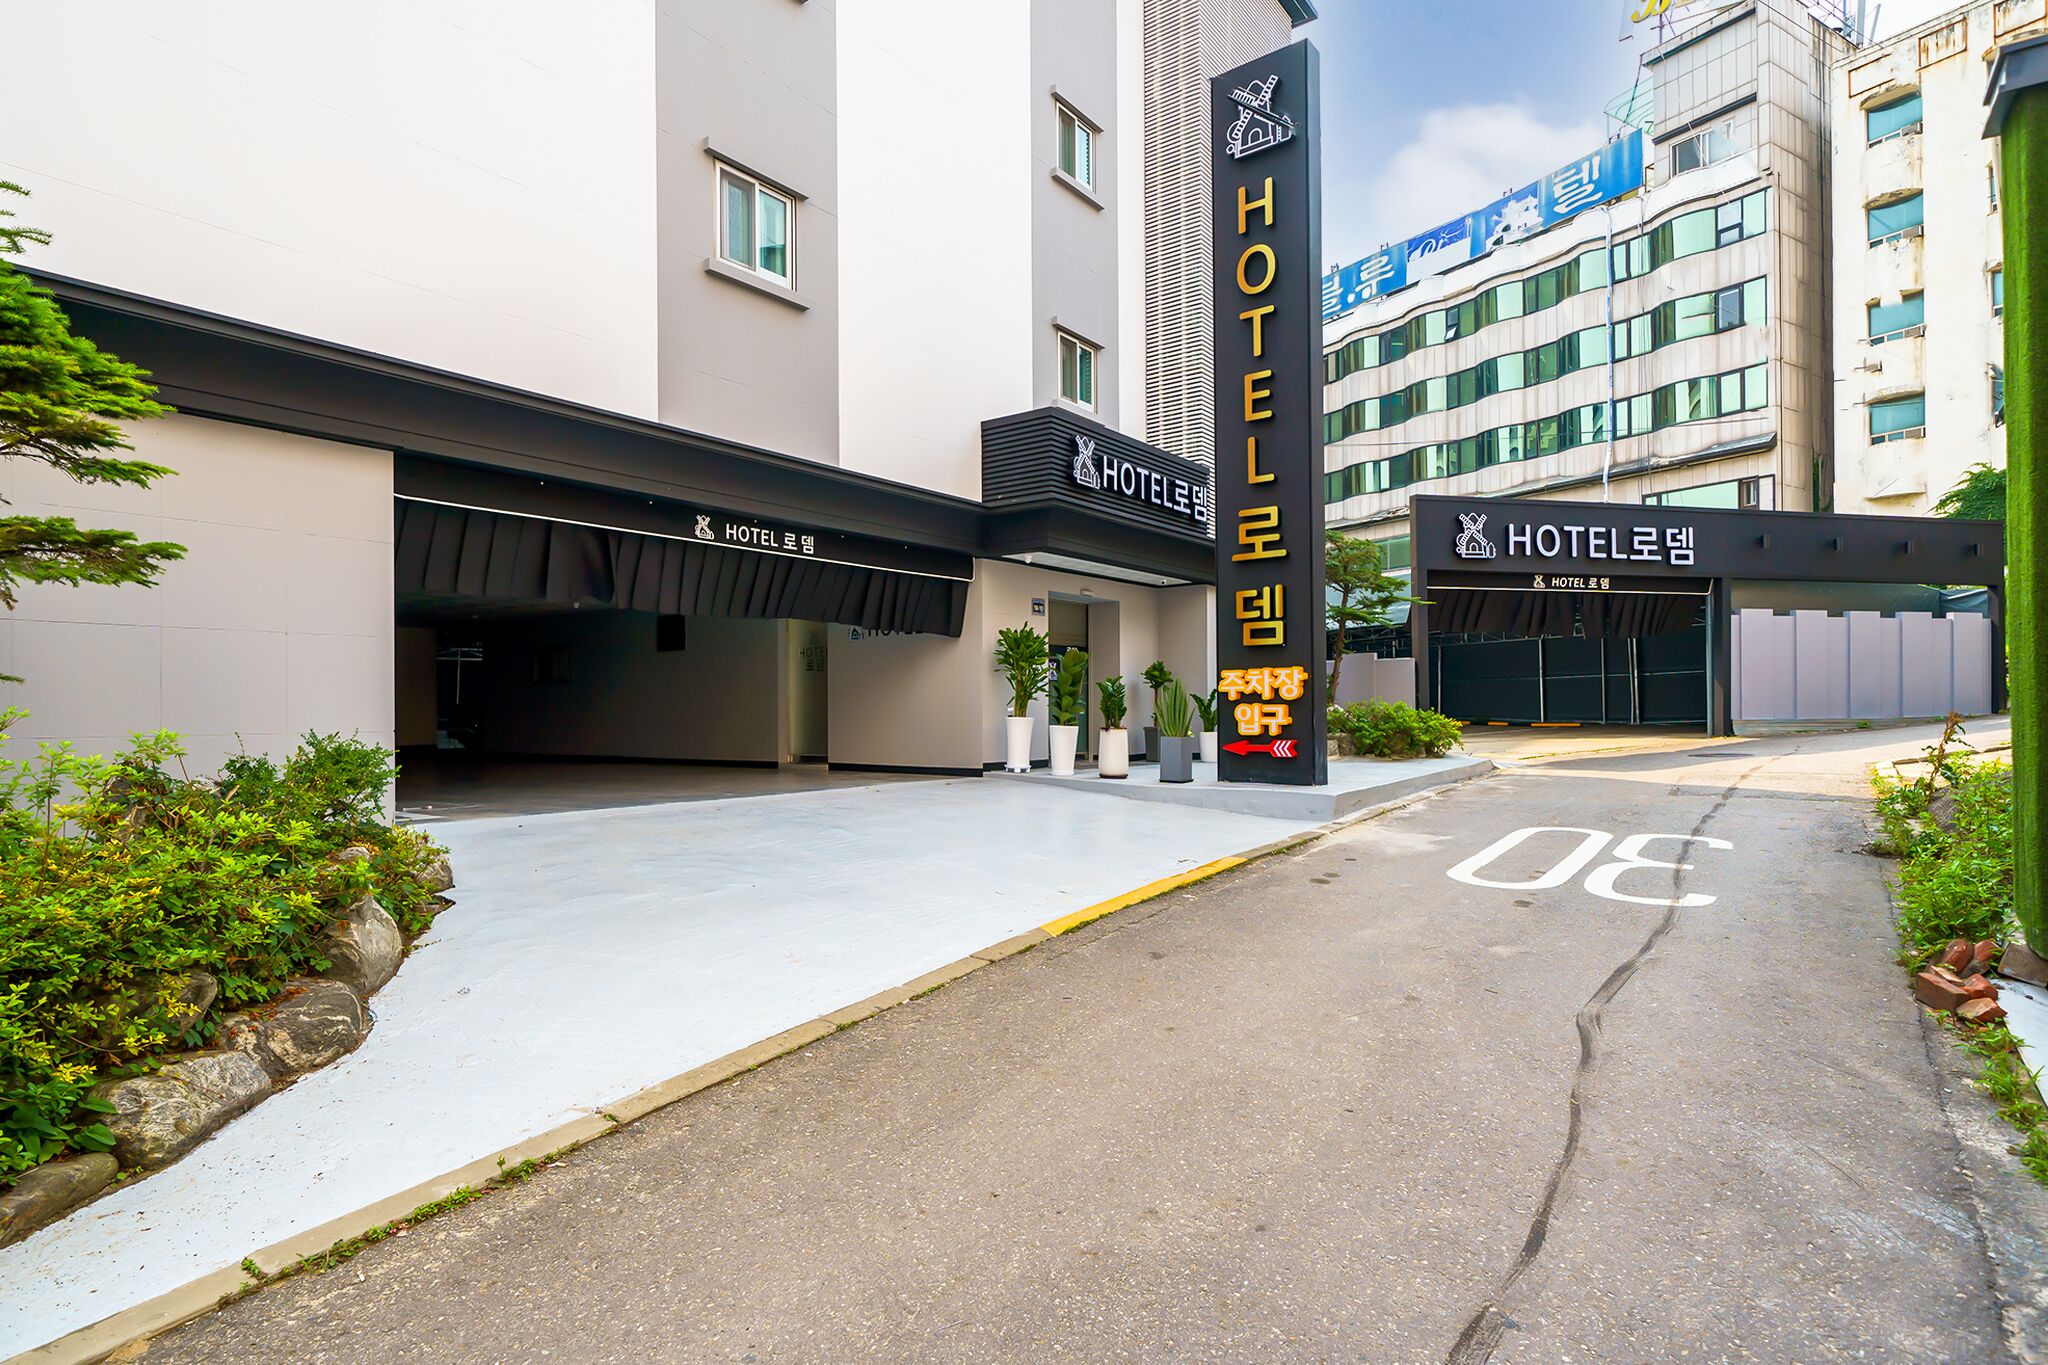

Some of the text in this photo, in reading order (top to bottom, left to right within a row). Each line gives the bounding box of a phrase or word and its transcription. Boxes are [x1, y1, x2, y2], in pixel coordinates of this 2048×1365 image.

[1553, 155, 1603, 214] 텔
[725, 522, 779, 548] HOTEL
[1551, 576, 1586, 589] HOTEL
[1219, 666, 1308, 702] 주차장
[1234, 702, 1292, 736] 입구
[1446, 826, 1734, 907] 30
